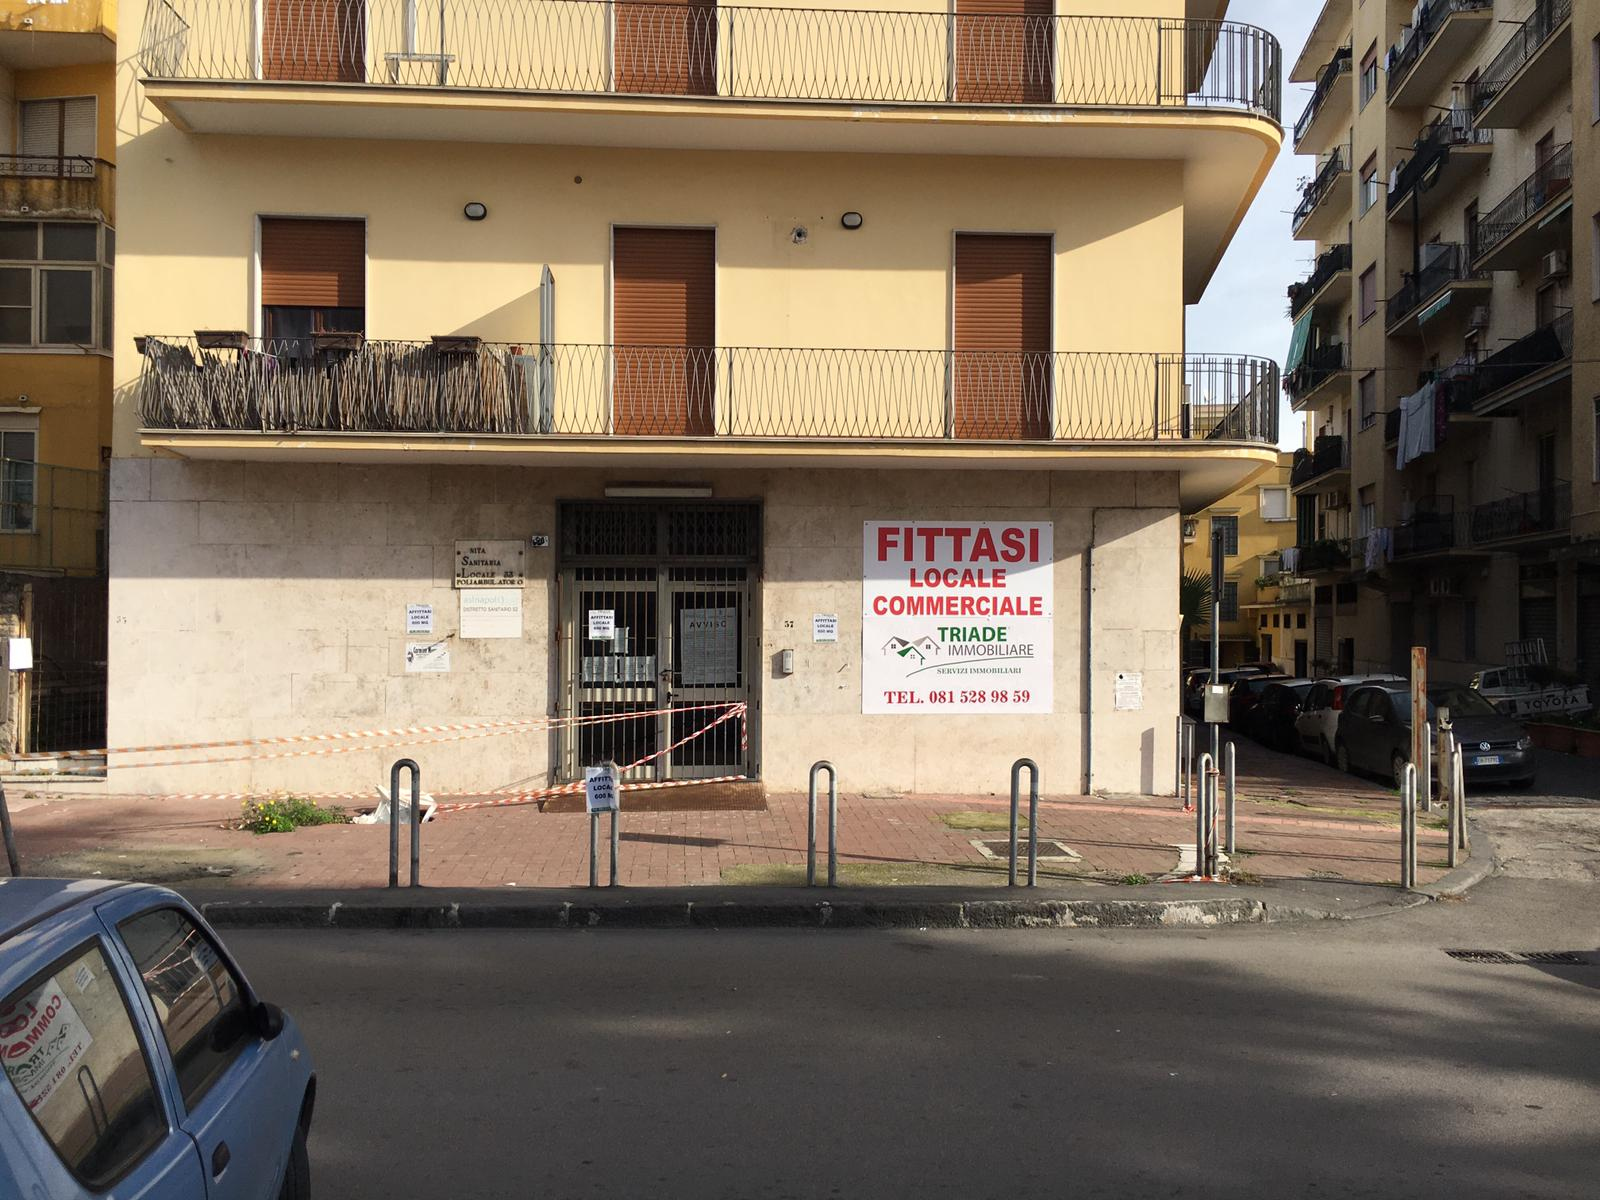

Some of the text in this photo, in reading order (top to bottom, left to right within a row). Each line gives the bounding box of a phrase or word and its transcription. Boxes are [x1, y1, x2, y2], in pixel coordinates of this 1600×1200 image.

[877, 527, 1040, 562] FITTASI
[910, 568, 1006, 588] LOCALE
[873, 596, 1043, 616] COMMERCIALE
[937, 626, 1007, 642] TRIADE
[948, 644, 1034, 656] IMMOBILIARE
[884, 690, 1030, 704] TEL. 081 528 98 59
[1525, 695, 1578, 709] TOYOTA
